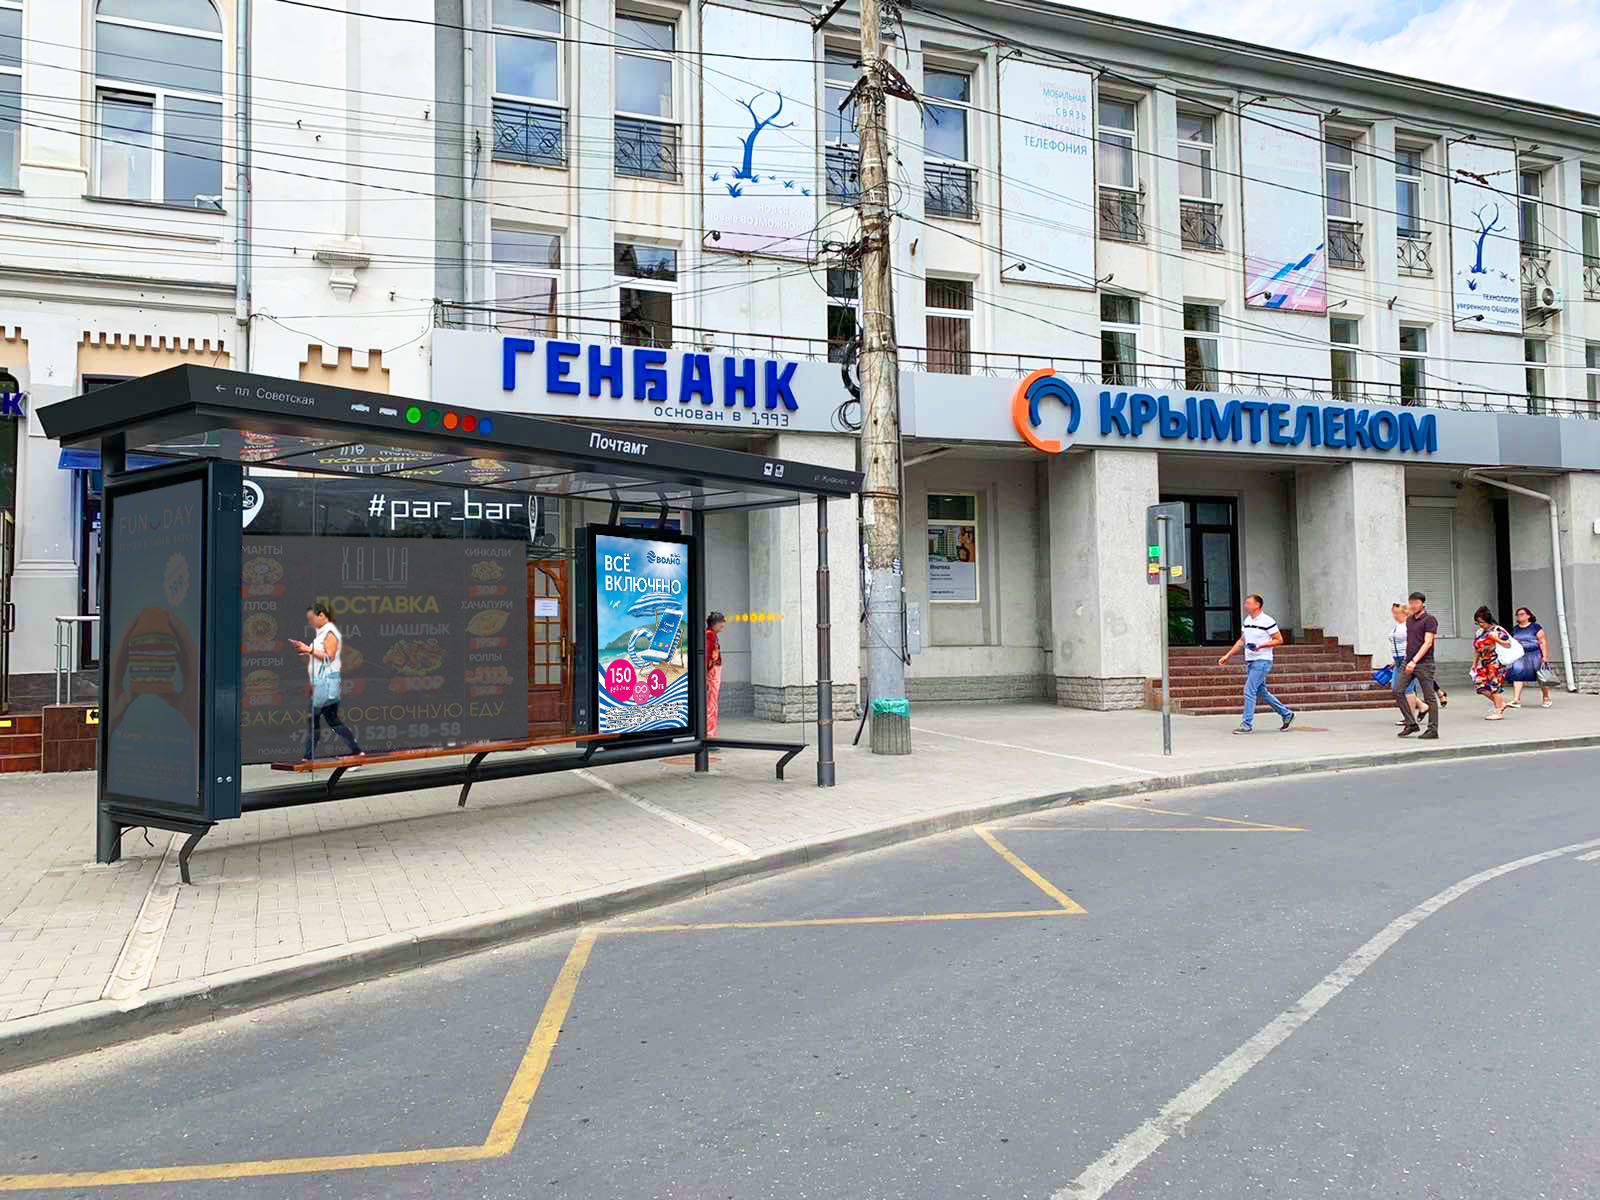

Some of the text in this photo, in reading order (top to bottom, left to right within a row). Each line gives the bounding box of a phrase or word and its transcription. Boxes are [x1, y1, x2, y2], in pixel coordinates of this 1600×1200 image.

[1056, 107, 1087, 121] СВЯЗЬ
[1024, 135, 1088, 156] ТЕЛЕФОНИЯ
[503, 336, 799, 411] ГЕНБАНК
[256, 387, 315, 406] Советская
[752, 412, 789, 427] 1993
[1099, 390, 1438, 454] КРЫМТЕЛЕКОМ
[589, 432, 649, 457] Почтамт
[120, 503, 194, 536] FUN DAY
[368, 488, 523, 531] #par_bar
[604, 552, 631, 573] ВСЁ
[604, 574, 682, 595] ВКЛЮЧЕНО
[380, 623, 451, 635] ШАШЛЫК
[245, 657, 284, 667] УРГЕРЫ
[469, 653, 502, 662] РОЛЛЫ
[609, 667, 632, 684] 150
[241, 707, 310, 728] ЗАКАЖ
[469, 701, 504, 718] ЕДУ
